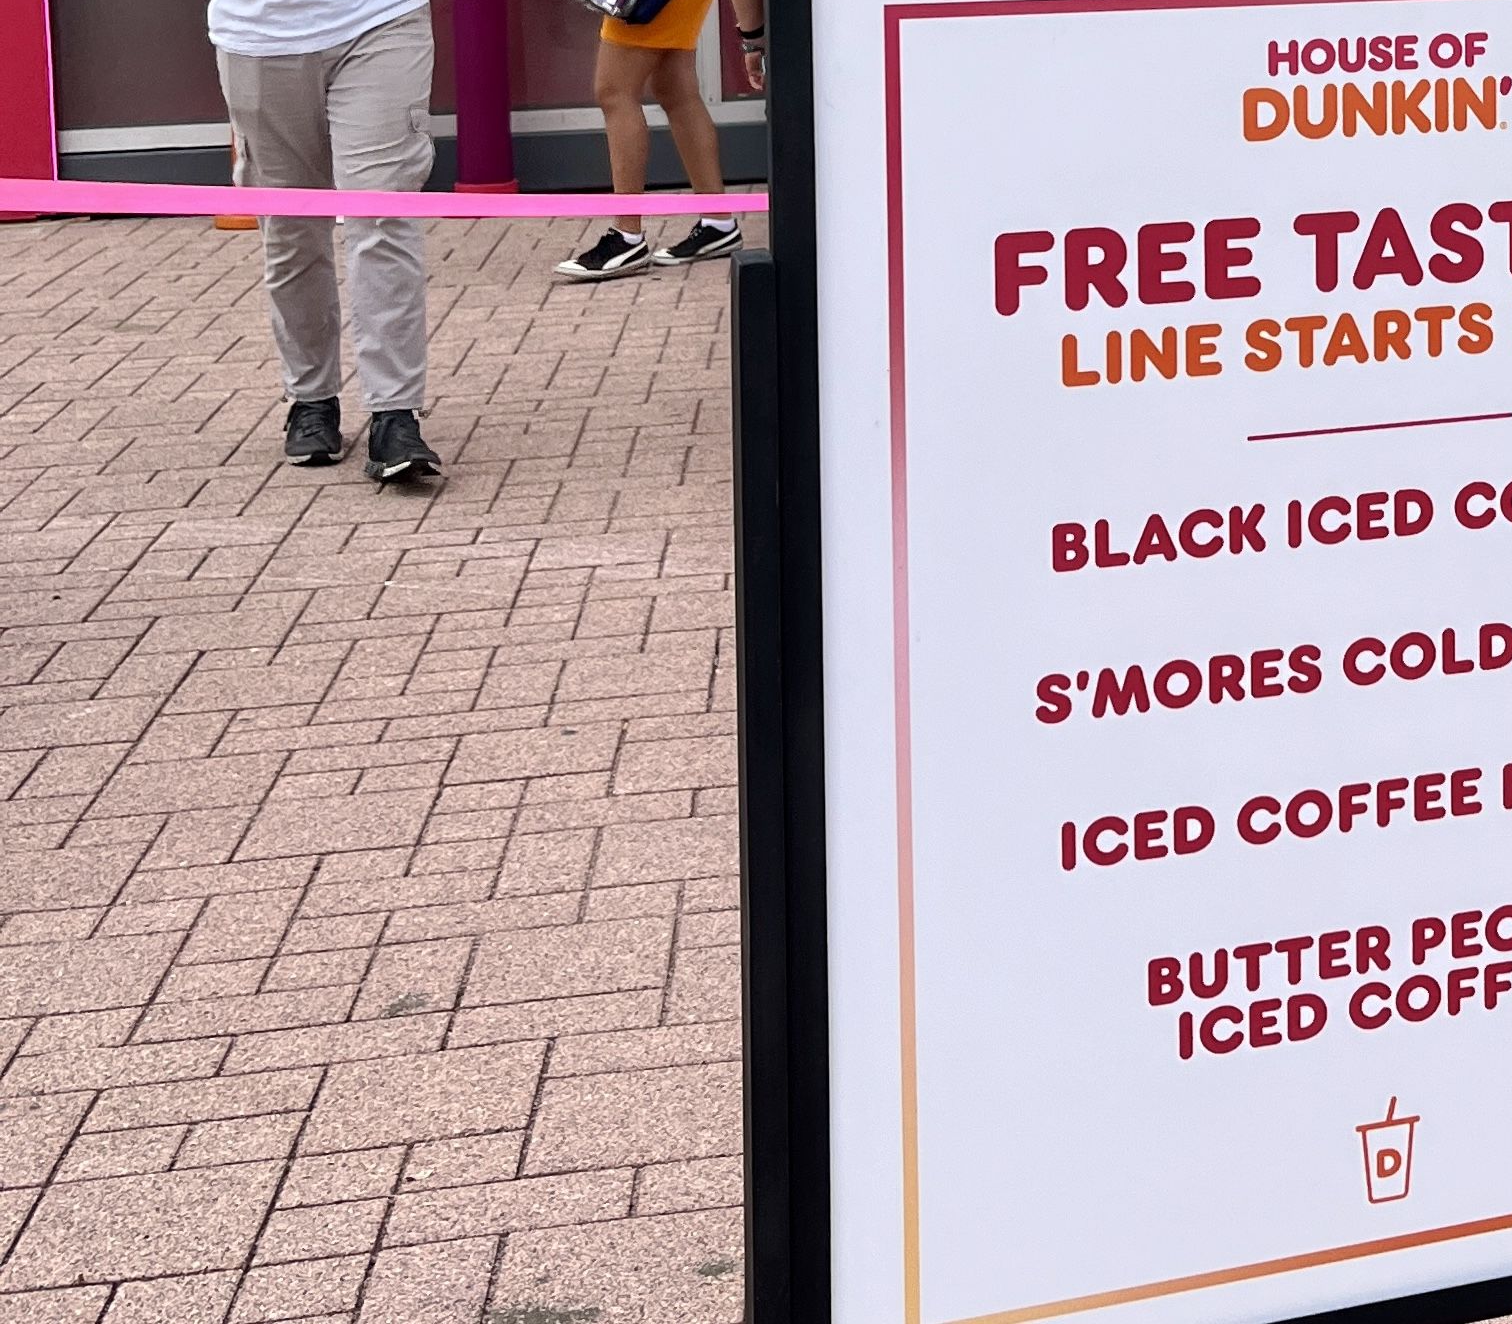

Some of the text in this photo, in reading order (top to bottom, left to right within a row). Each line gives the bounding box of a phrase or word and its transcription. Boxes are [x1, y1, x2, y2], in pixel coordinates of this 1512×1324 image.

[1267, 32, 1489, 77] HOUSE OF
[1242, 75, 1512, 142] DUNKIN'
[994, 217, 1262, 317] FREE
[1061, 323, 1223, 388] LINE
[1244, 297, 1494, 373] STARTS
[1052, 503, 1266, 573] BLACK
[1287, 488, 1434, 549] ICED
[1035, 644, 1322, 724] S'MORES
[1061, 806, 1215, 871] ICED
[1236, 767, 1483, 845] COFFEE
[1147, 925, 1391, 1007] BUTTER
[1178, 993, 1328, 1060] ICED
[1376, 1148, 1402, 1178] D
